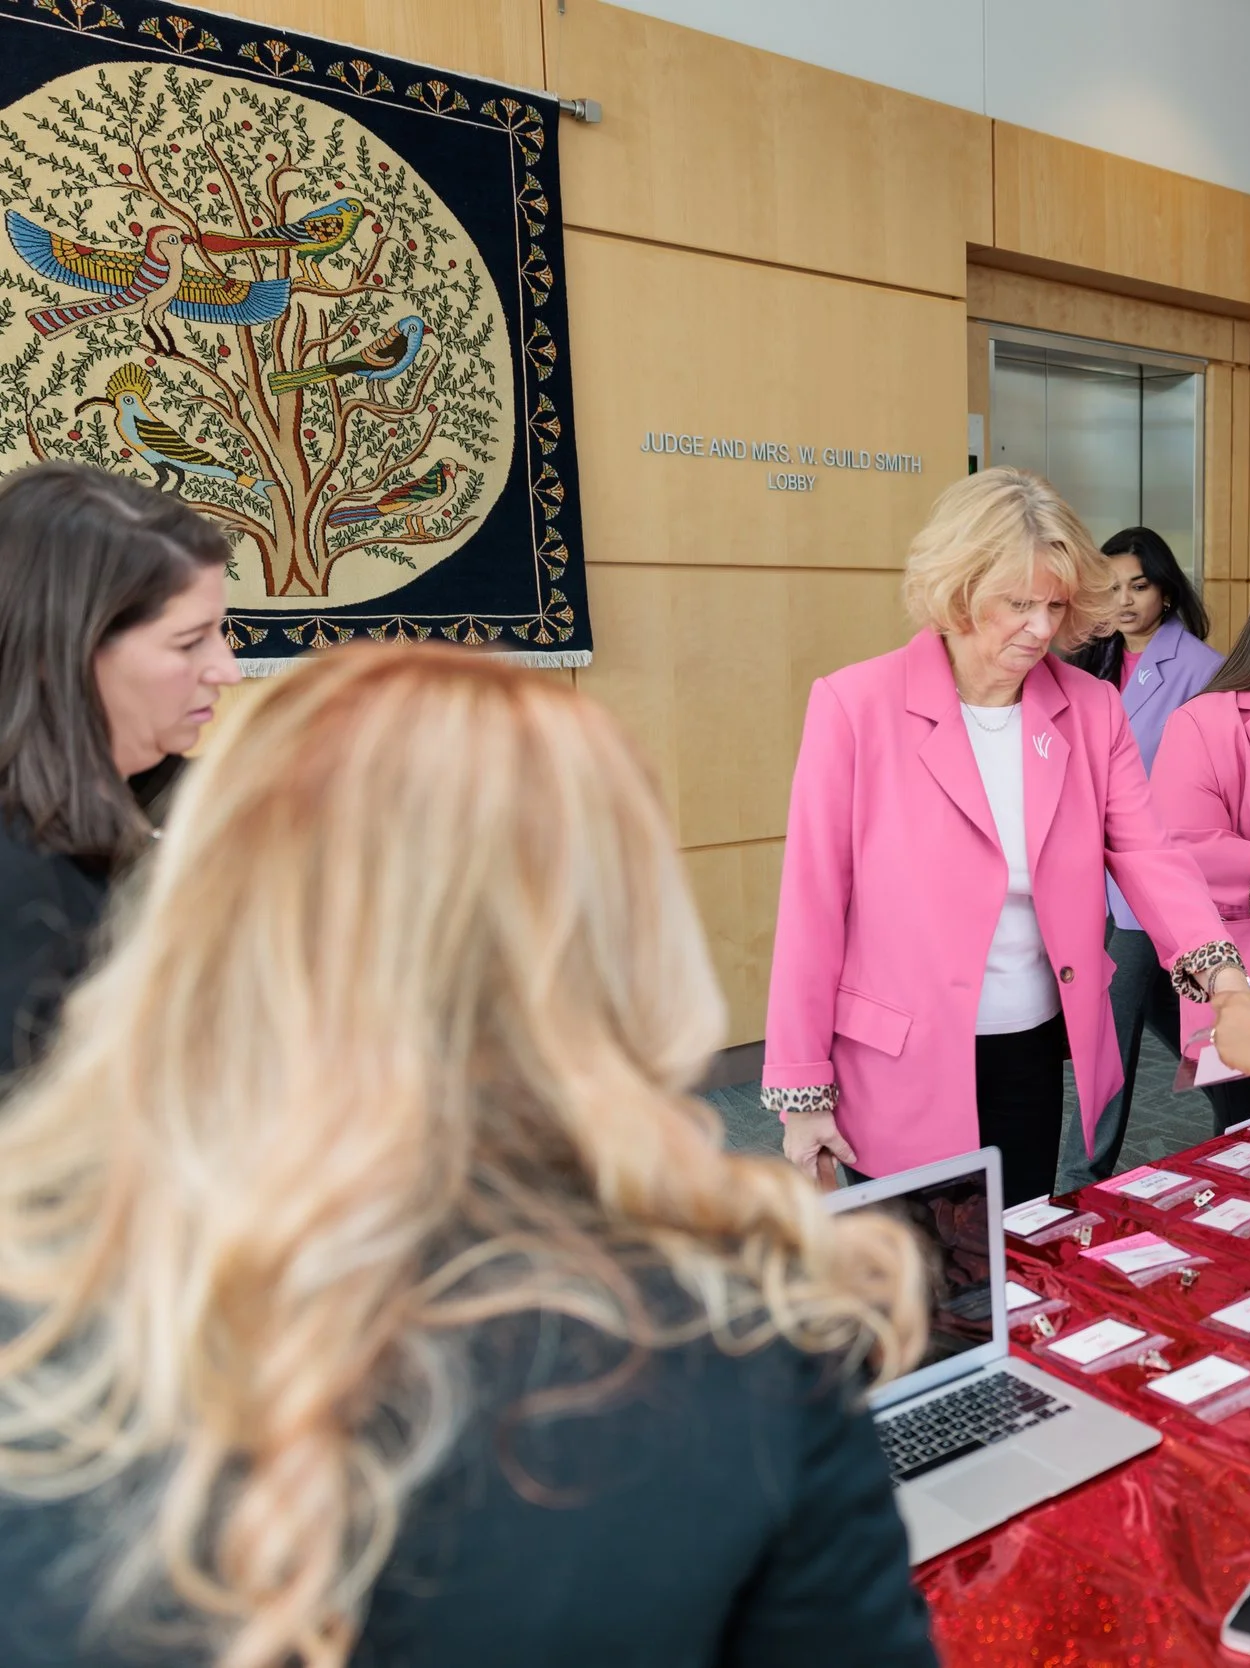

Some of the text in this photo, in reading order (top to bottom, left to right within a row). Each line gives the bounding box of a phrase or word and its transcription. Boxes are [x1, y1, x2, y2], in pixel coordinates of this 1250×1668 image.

[641, 431, 922, 474] JUDGE AND MRS. W. GUILD SMITH
[767, 472, 816, 492] LOBBY
